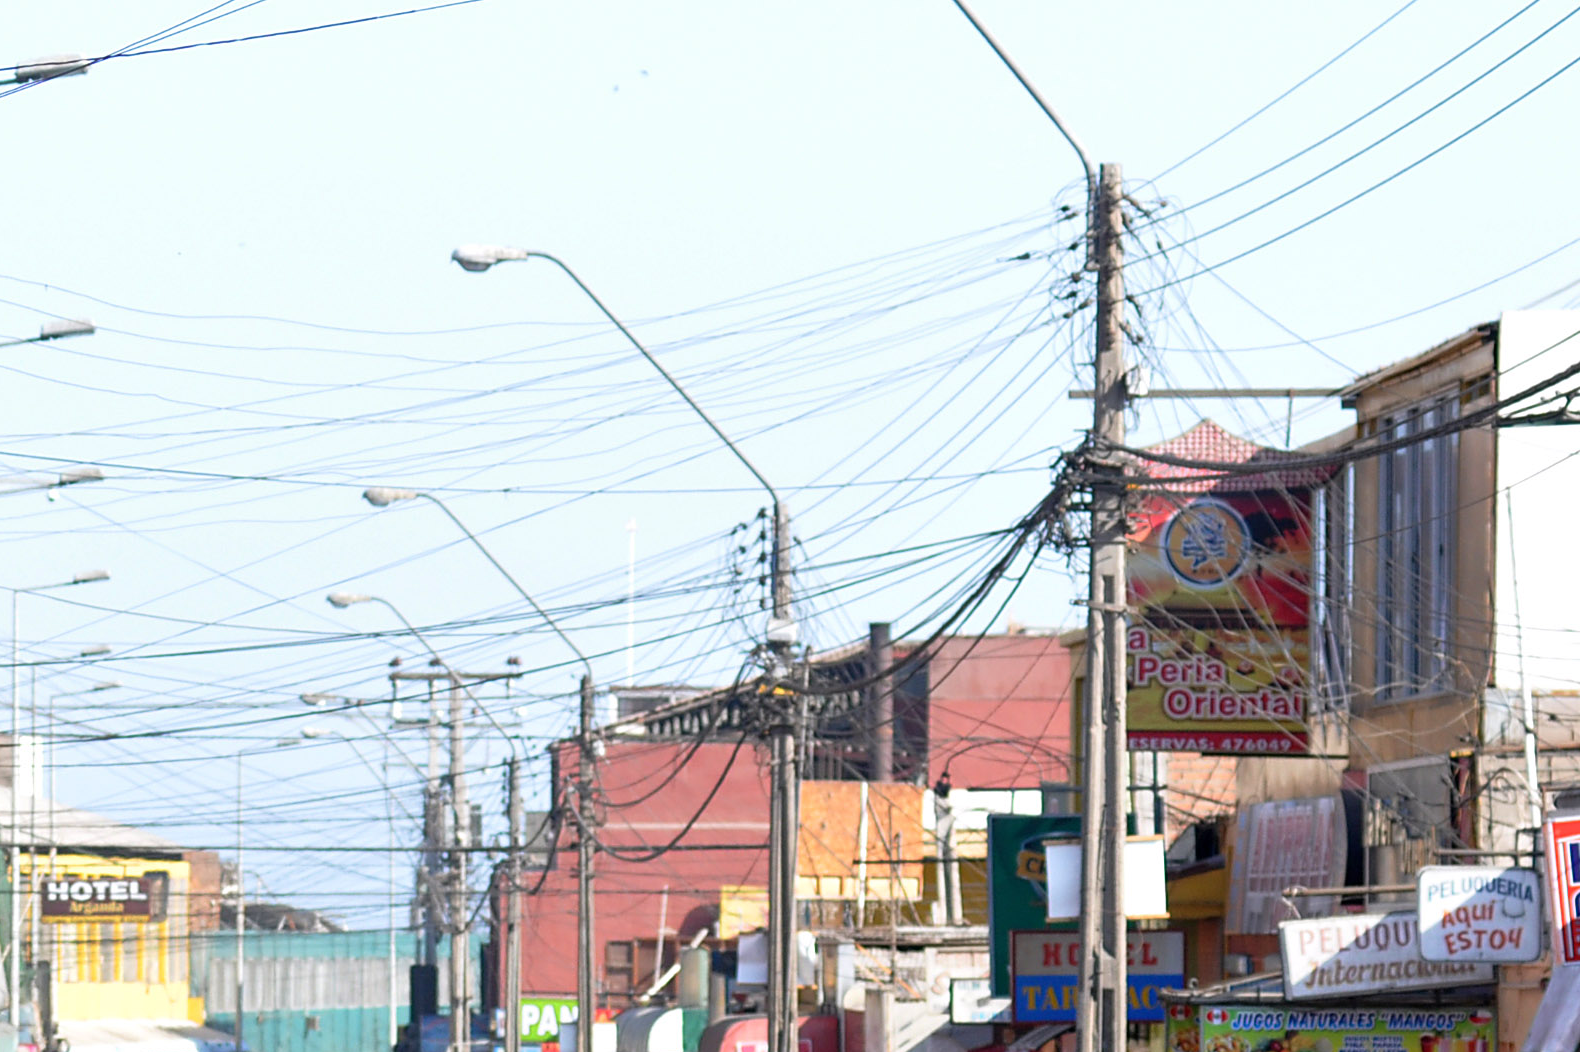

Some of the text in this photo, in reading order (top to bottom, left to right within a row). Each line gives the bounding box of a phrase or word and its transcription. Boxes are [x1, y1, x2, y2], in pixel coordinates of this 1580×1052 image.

[1128, 629, 1147, 650] a
[1138, 657, 1224, 682] Perla
[1167, 688, 1302, 716] Oriental
[1128, 738, 1291, 751] ESERVAS: 476049
[47, 880, 148, 901] HOTEL
[1427, 876, 1534, 904] PELUQUERIA
[1299, 921, 1418, 957] PELUQU
[1042, 943, 1157, 967] HOL
[1231, 1012, 1283, 1030] JUGOS
[1286, 1012, 1375, 1031] NATURALES
